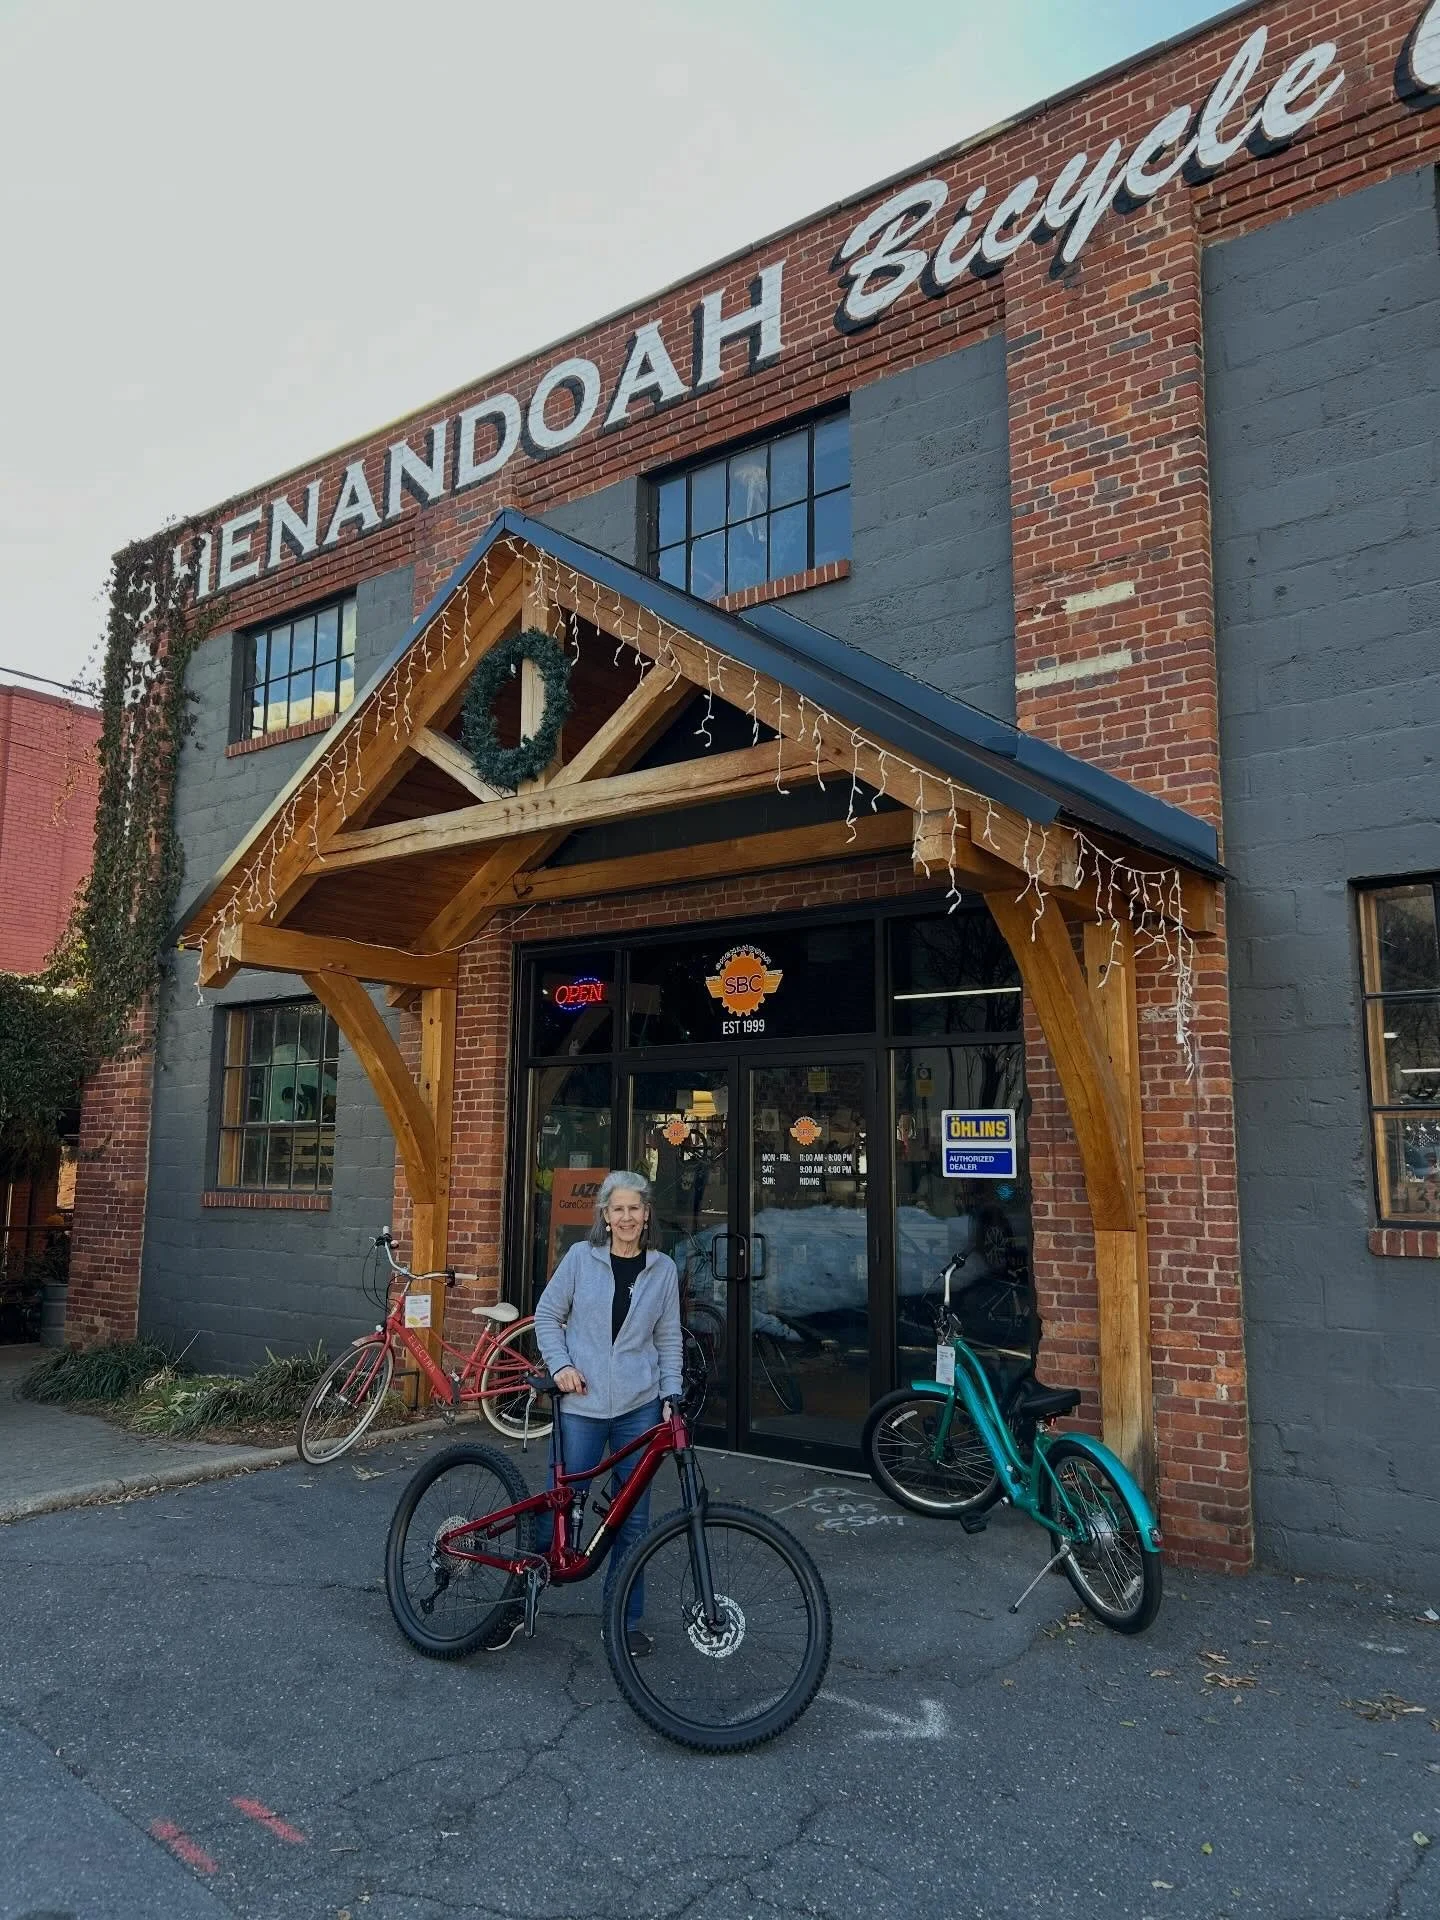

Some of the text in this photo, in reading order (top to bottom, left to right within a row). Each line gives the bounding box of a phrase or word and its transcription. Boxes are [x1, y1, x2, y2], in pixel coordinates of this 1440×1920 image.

[840, 26, 1346, 322] Bicycle
[725, 974, 761, 995] SBC
[555, 983, 604, 1005] OPEN
[722, 1019, 765, 1035] EST 1999
[950, 1116, 1007, 1138] ÖHLINS
[761, 1153, 776, 1162] MON
[813, 1153, 824, 1162] AM
[842, 1153, 853, 1162] PM
[949, 1155, 995, 1163] AUTHORIZED
[761, 1165, 775, 1174] SAT:
[799, 1165, 813, 1174] 9:00
[813, 1165, 823, 1174] AM
[827, 1165, 841, 1174] 4:00
[841, 1165, 852, 1174] PM
[949, 1163, 978, 1171] DEALER
[761, 1176, 820, 1186] SUN: RIDING
[407, 1333, 435, 1373] ELECTRA
